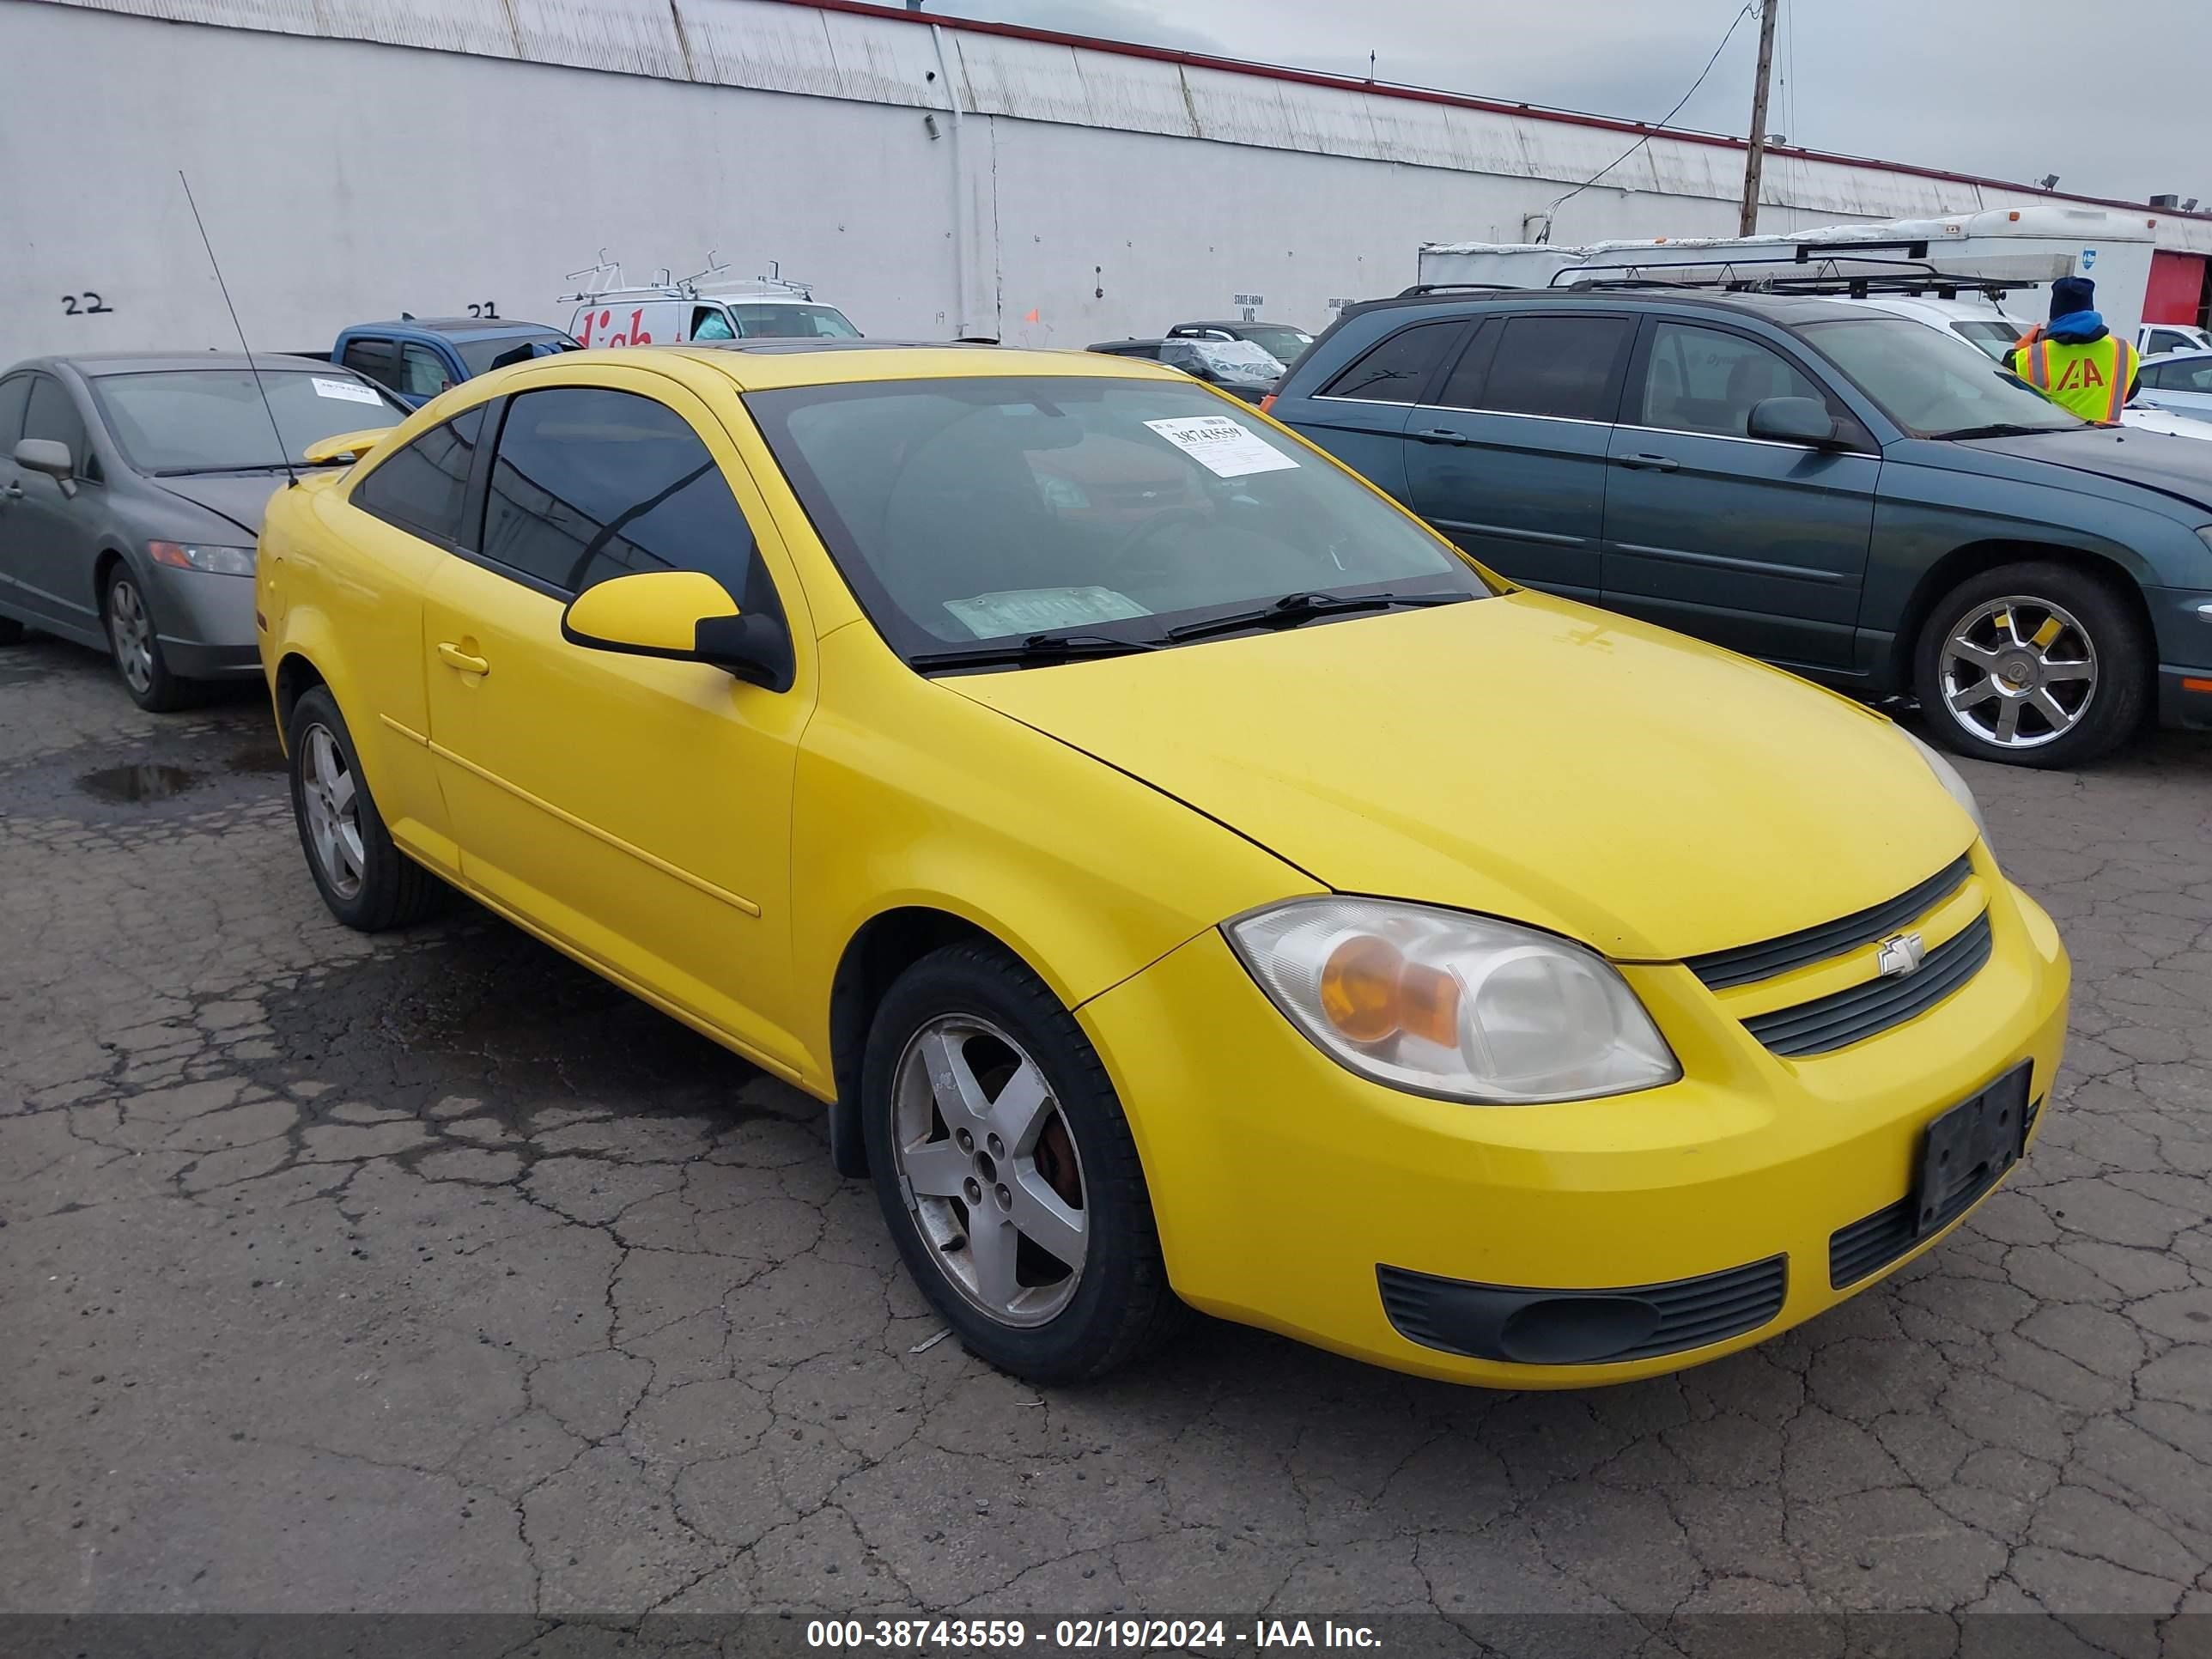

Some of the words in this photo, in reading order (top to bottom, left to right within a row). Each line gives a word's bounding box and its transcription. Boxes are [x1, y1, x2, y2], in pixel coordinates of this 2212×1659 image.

[62, 292, 113, 316] 22
[1234, 294, 1249, 305] STATE
[1249, 295, 1264, 306] FARM
[1328, 298, 1341, 309] STATE
[467, 301, 501, 319] 21
[1243, 307, 1255, 323] VIC
